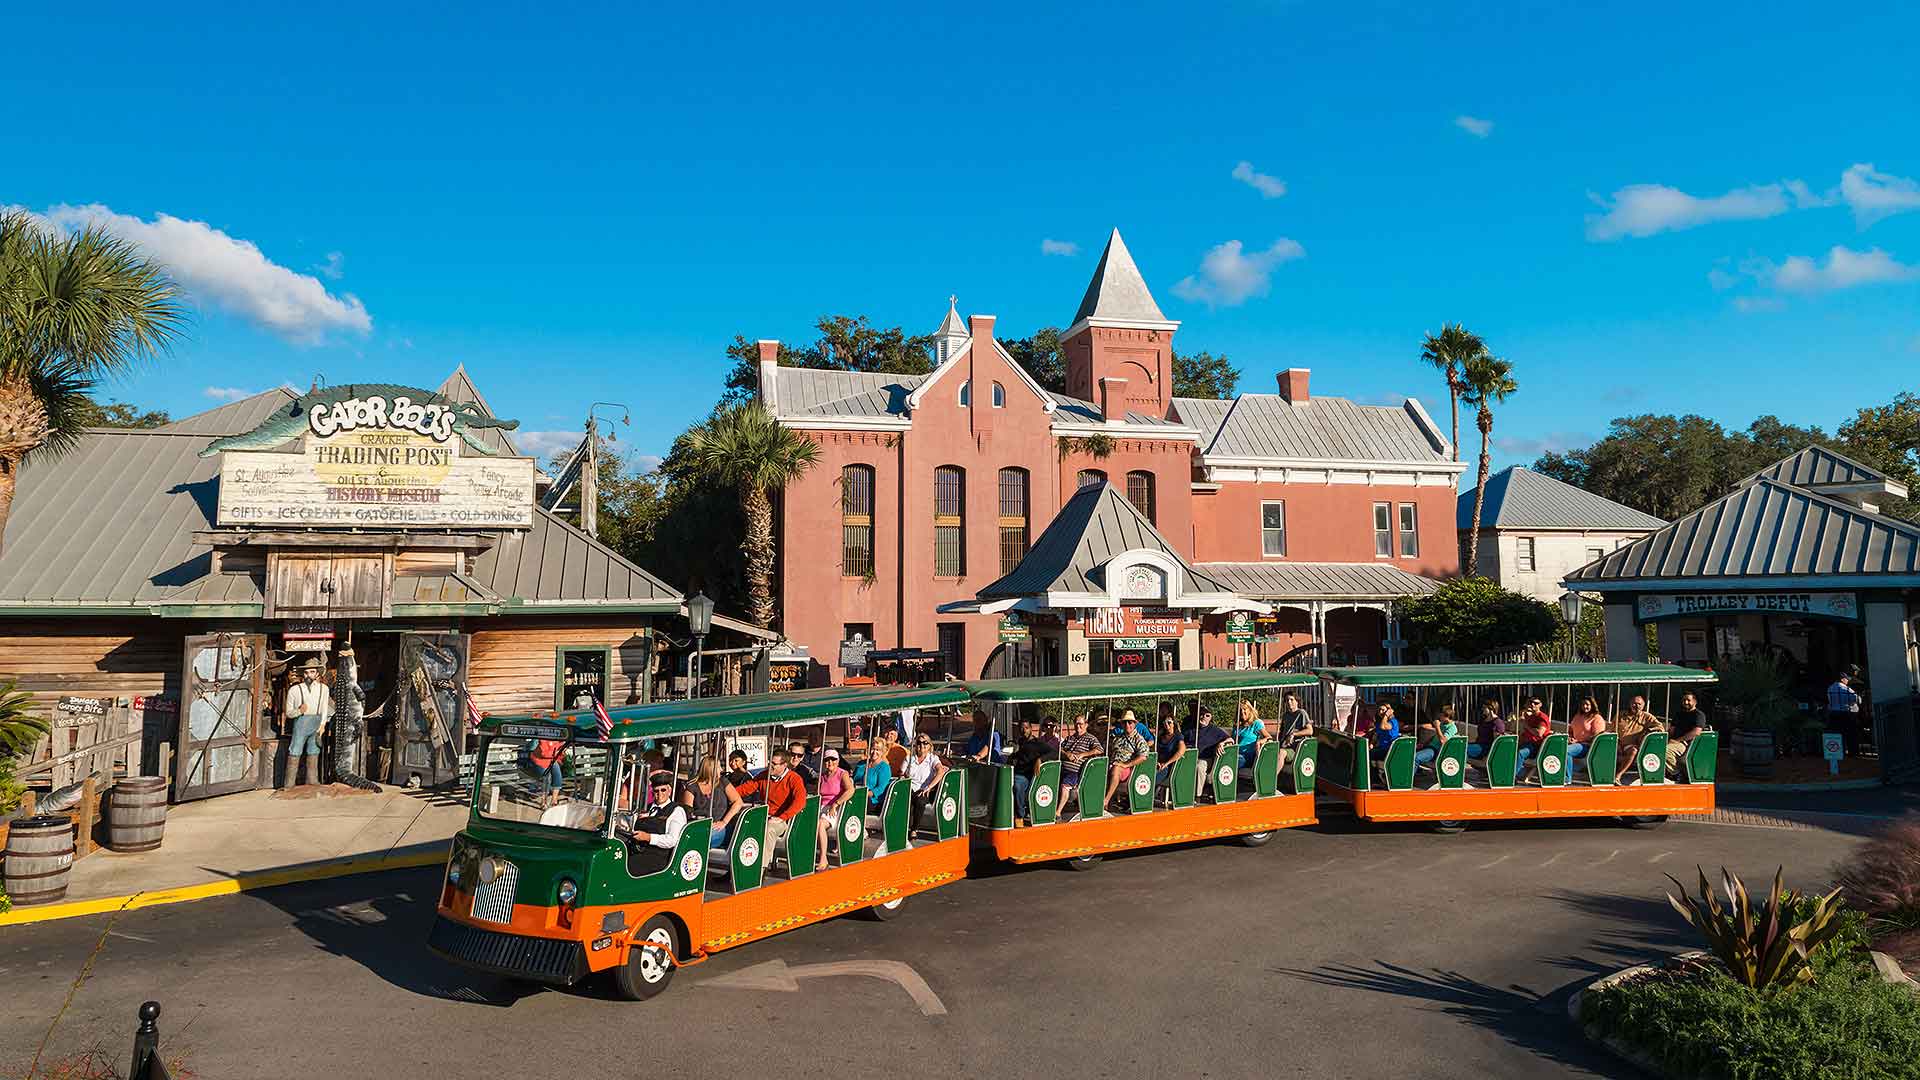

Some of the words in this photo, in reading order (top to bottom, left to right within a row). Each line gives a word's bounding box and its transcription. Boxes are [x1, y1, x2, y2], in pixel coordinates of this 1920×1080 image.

[309, 396, 388, 437] GATOR
[360, 434, 409, 445] CRACKER
[315, 446, 400, 465] TRADING
[405, 447, 452, 466] POST
[327, 487, 384, 501] HISTORY
[387, 488, 441, 503] MUSEUM
[231, 507, 263, 519] GIFTS
[277, 507, 297, 519] ICE
[299, 507, 340, 519] CREAM
[355, 508, 397, 520] GATOR
[450, 510, 480, 521] COLD
[483, 510, 523, 521] DRINKS
[1675, 595, 1748, 612] TROLLEY
[1755, 595, 1810, 611] DEPOT
[1089, 607, 1124, 634] TICKETS
[1136, 626, 1177, 634] MUSEUM
[1071, 653, 1086, 662] 167
[1117, 654, 1143, 665] OPEN
[731, 743, 763, 751] PARKING
[614, 851, 623, 859] 36
